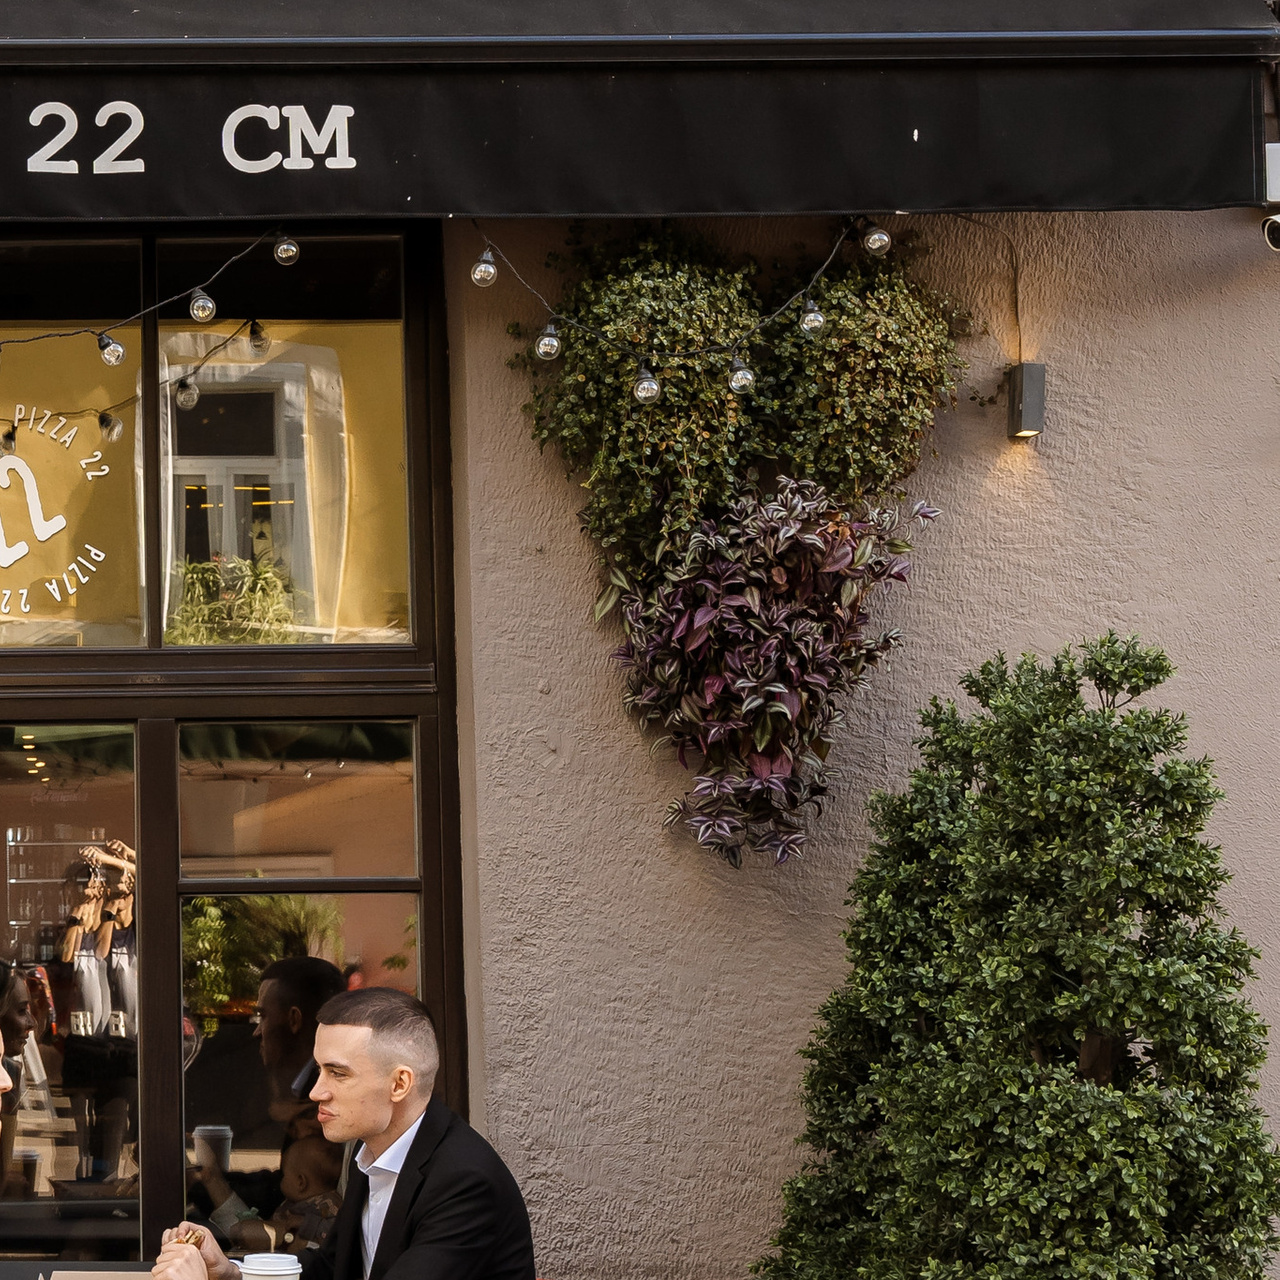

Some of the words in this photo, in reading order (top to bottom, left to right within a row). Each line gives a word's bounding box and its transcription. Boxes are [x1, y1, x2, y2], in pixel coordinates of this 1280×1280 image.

[26, 100, 146, 175] 22
[221, 103, 357, 171] CM
[14, 404, 78, 448] PIZZA
[79, 451, 110, 481] 22
[0, 589, 31, 613] 22
[45, 543, 107, 602] PIZZA
